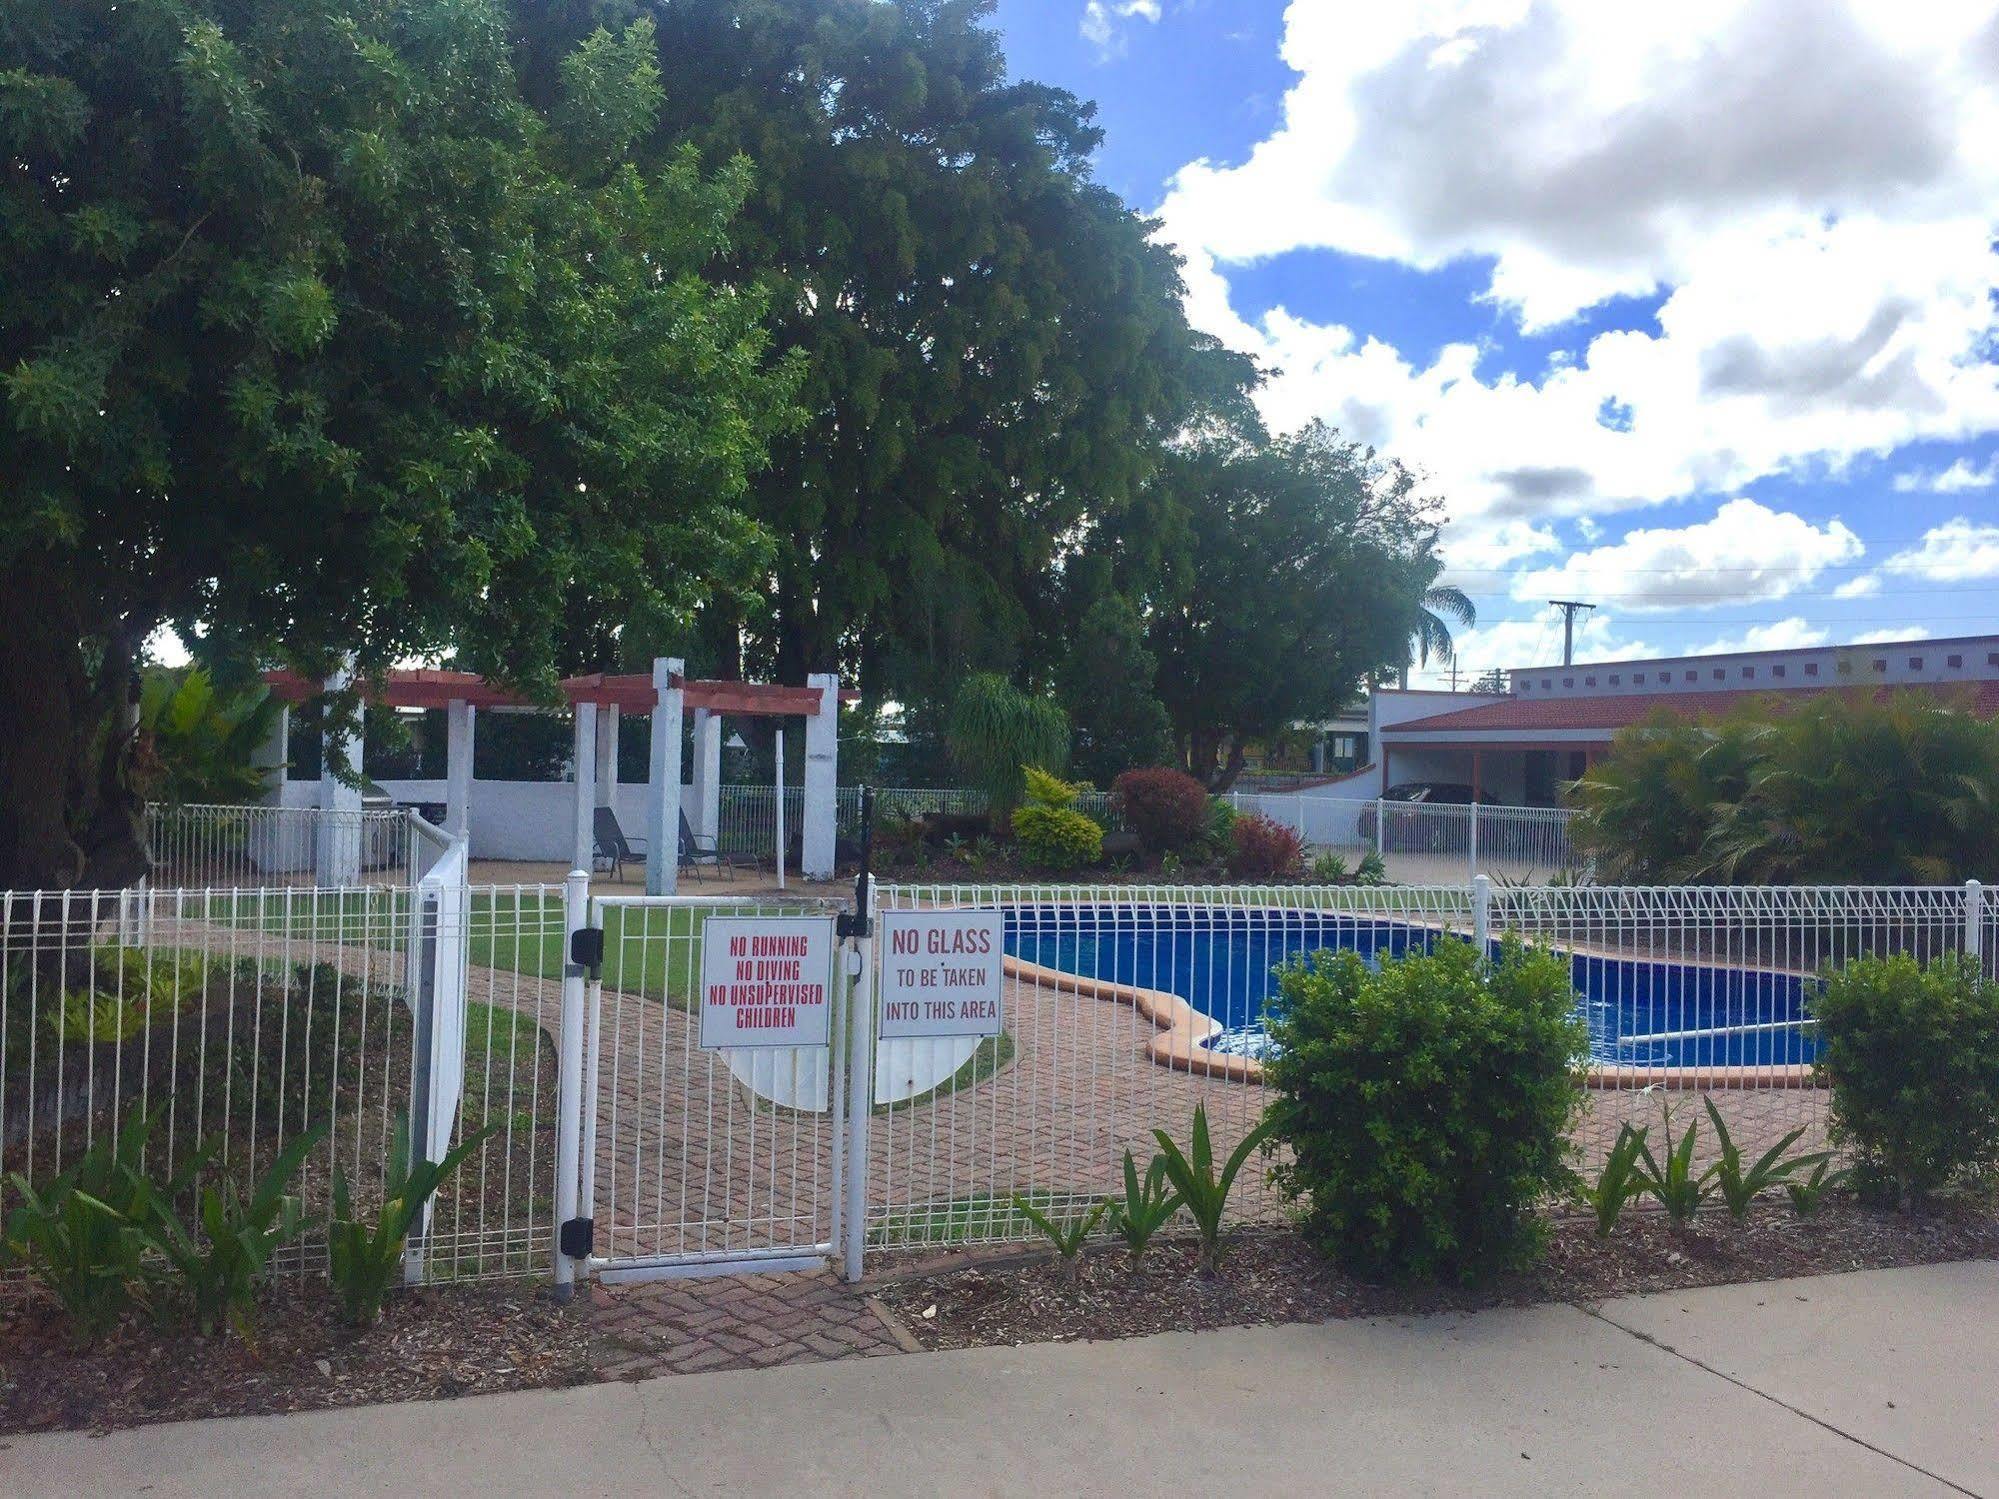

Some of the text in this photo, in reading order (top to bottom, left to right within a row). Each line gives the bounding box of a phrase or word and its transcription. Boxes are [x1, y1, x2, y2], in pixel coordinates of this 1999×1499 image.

[730, 936, 808, 956] NO RUNNING
[893, 929, 990, 954] NO GLASS
[736, 961, 800, 981] NO DIVING
[898, 968, 986, 987] TO BE TAKEN
[710, 984, 822, 1005] NO UNSUPERVISED
[736, 1008, 795, 1028] CHILDREN
[886, 1000, 996, 1020] INTO THIS AREA
